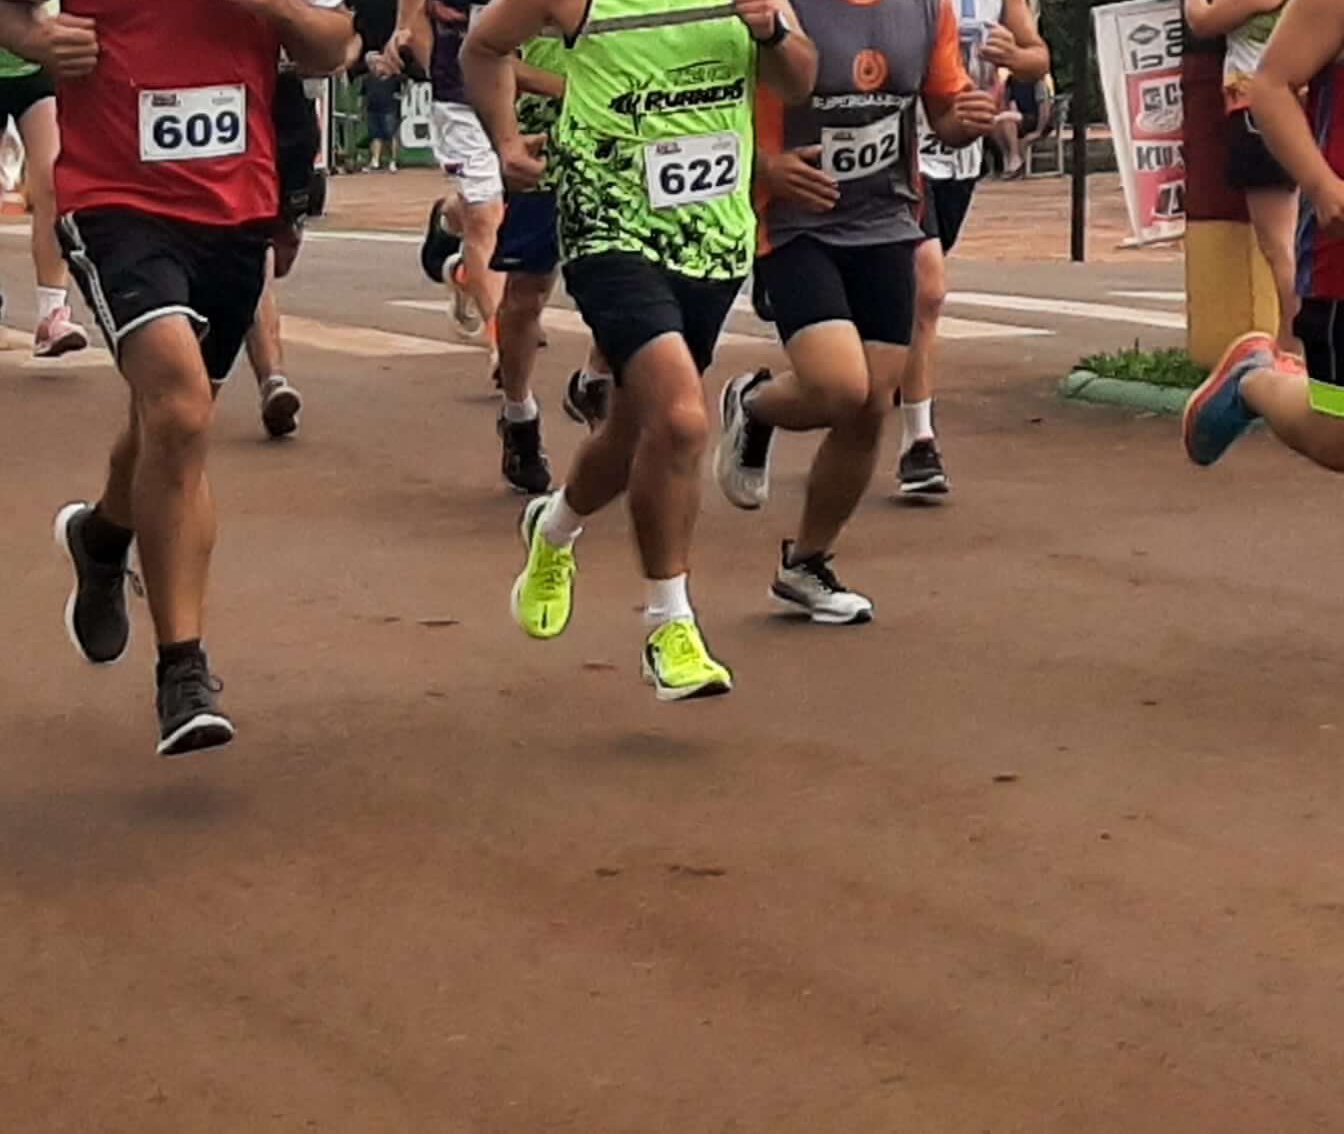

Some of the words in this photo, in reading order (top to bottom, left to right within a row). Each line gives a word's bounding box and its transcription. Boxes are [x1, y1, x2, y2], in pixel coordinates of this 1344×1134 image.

[153, 110, 240, 149] 609
[832, 132, 897, 173] 602
[659, 154, 735, 195] 622
